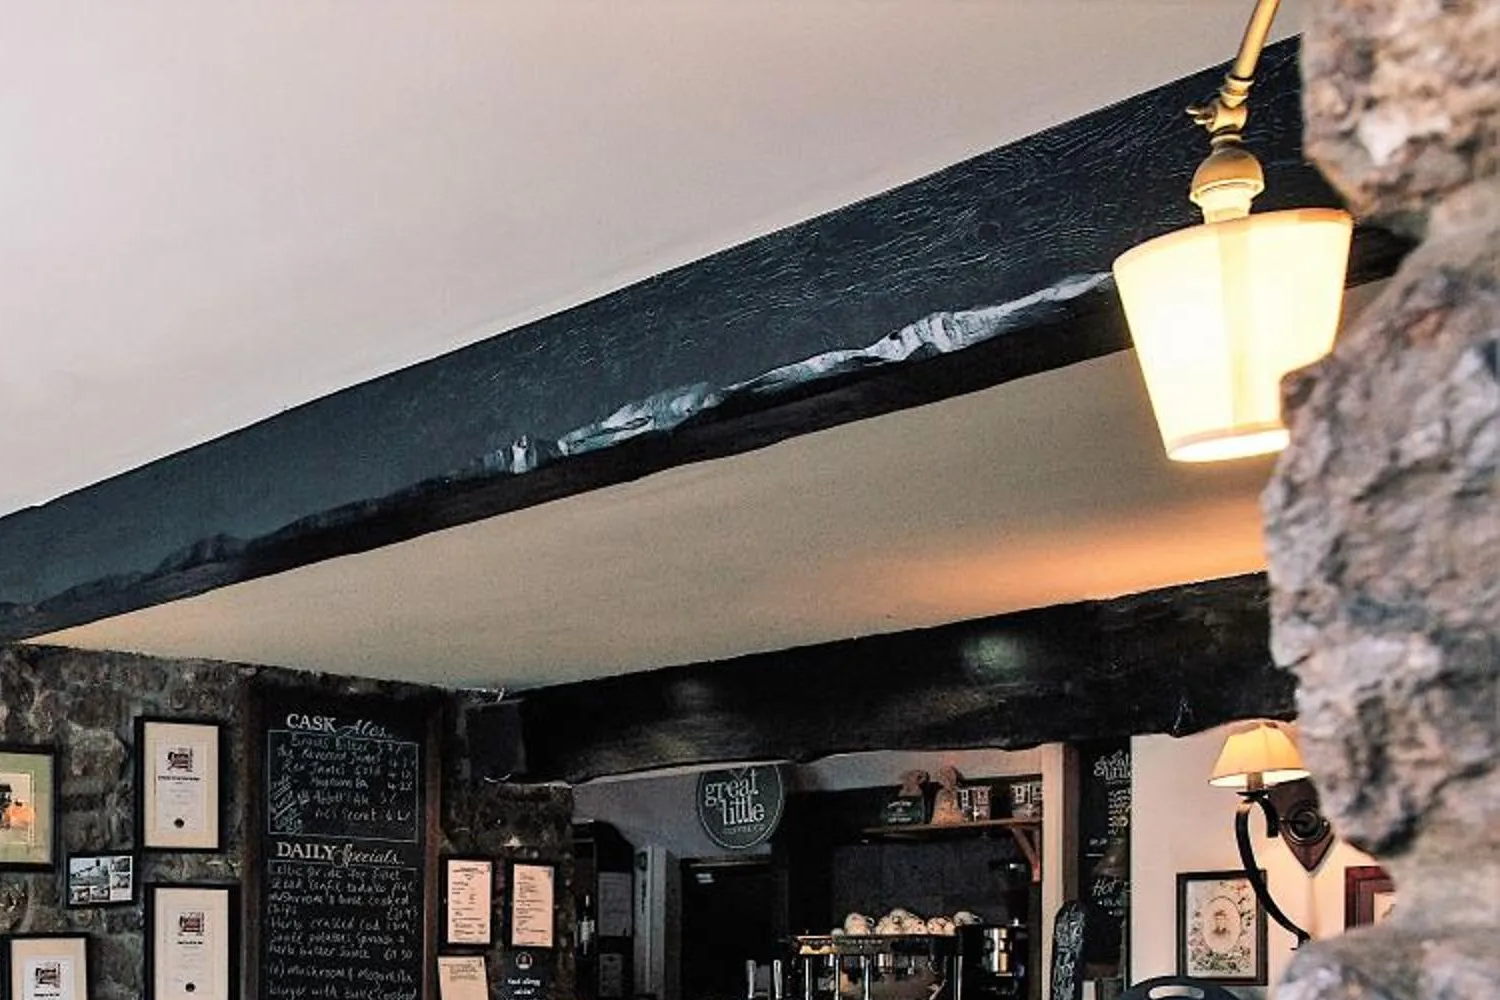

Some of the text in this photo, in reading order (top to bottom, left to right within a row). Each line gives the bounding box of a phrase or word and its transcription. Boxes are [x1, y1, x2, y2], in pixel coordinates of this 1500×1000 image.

[286, 713, 336, 732] CASK
[705, 769, 759, 807] great
[719, 795, 765, 825] little
[276, 842, 336, 859] DAILY
